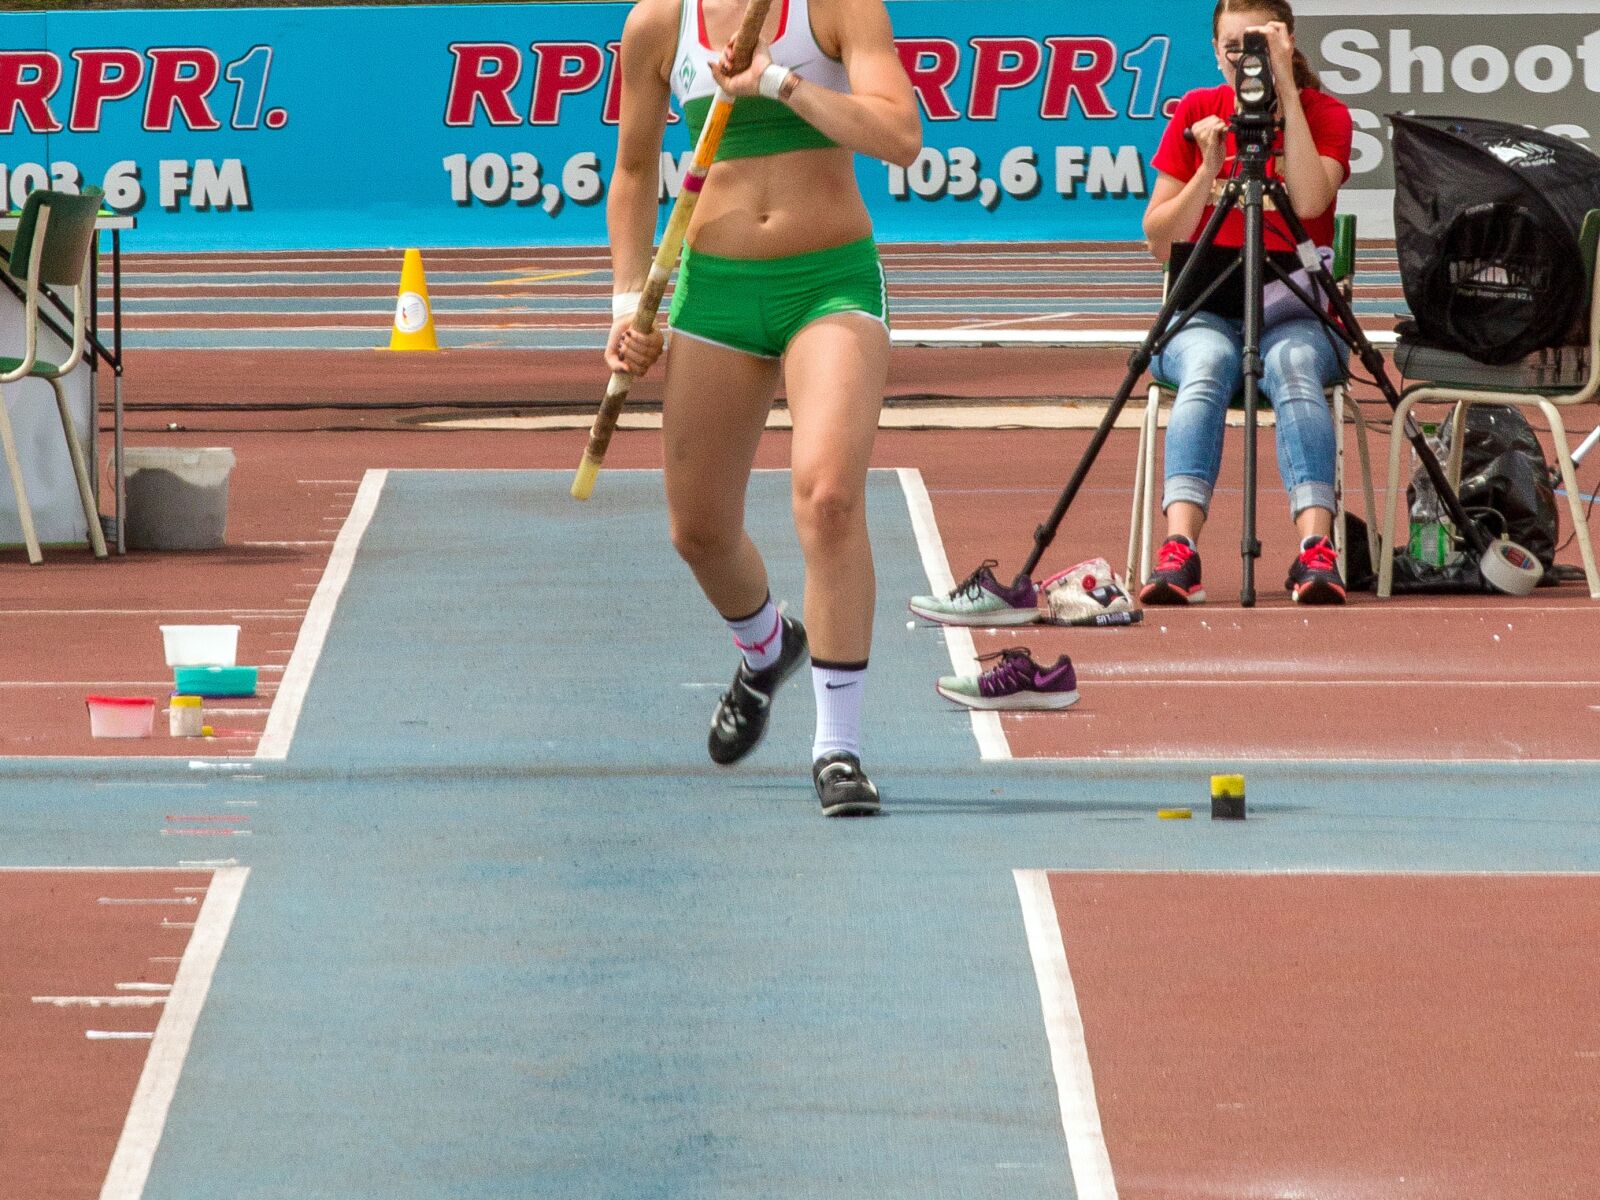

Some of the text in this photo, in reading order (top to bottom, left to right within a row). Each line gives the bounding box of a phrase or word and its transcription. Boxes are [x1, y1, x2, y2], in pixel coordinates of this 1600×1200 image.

[158, 158, 251, 210] FM
[442, 151, 604, 216] 103,6
[1055, 145, 1147, 196] FM
